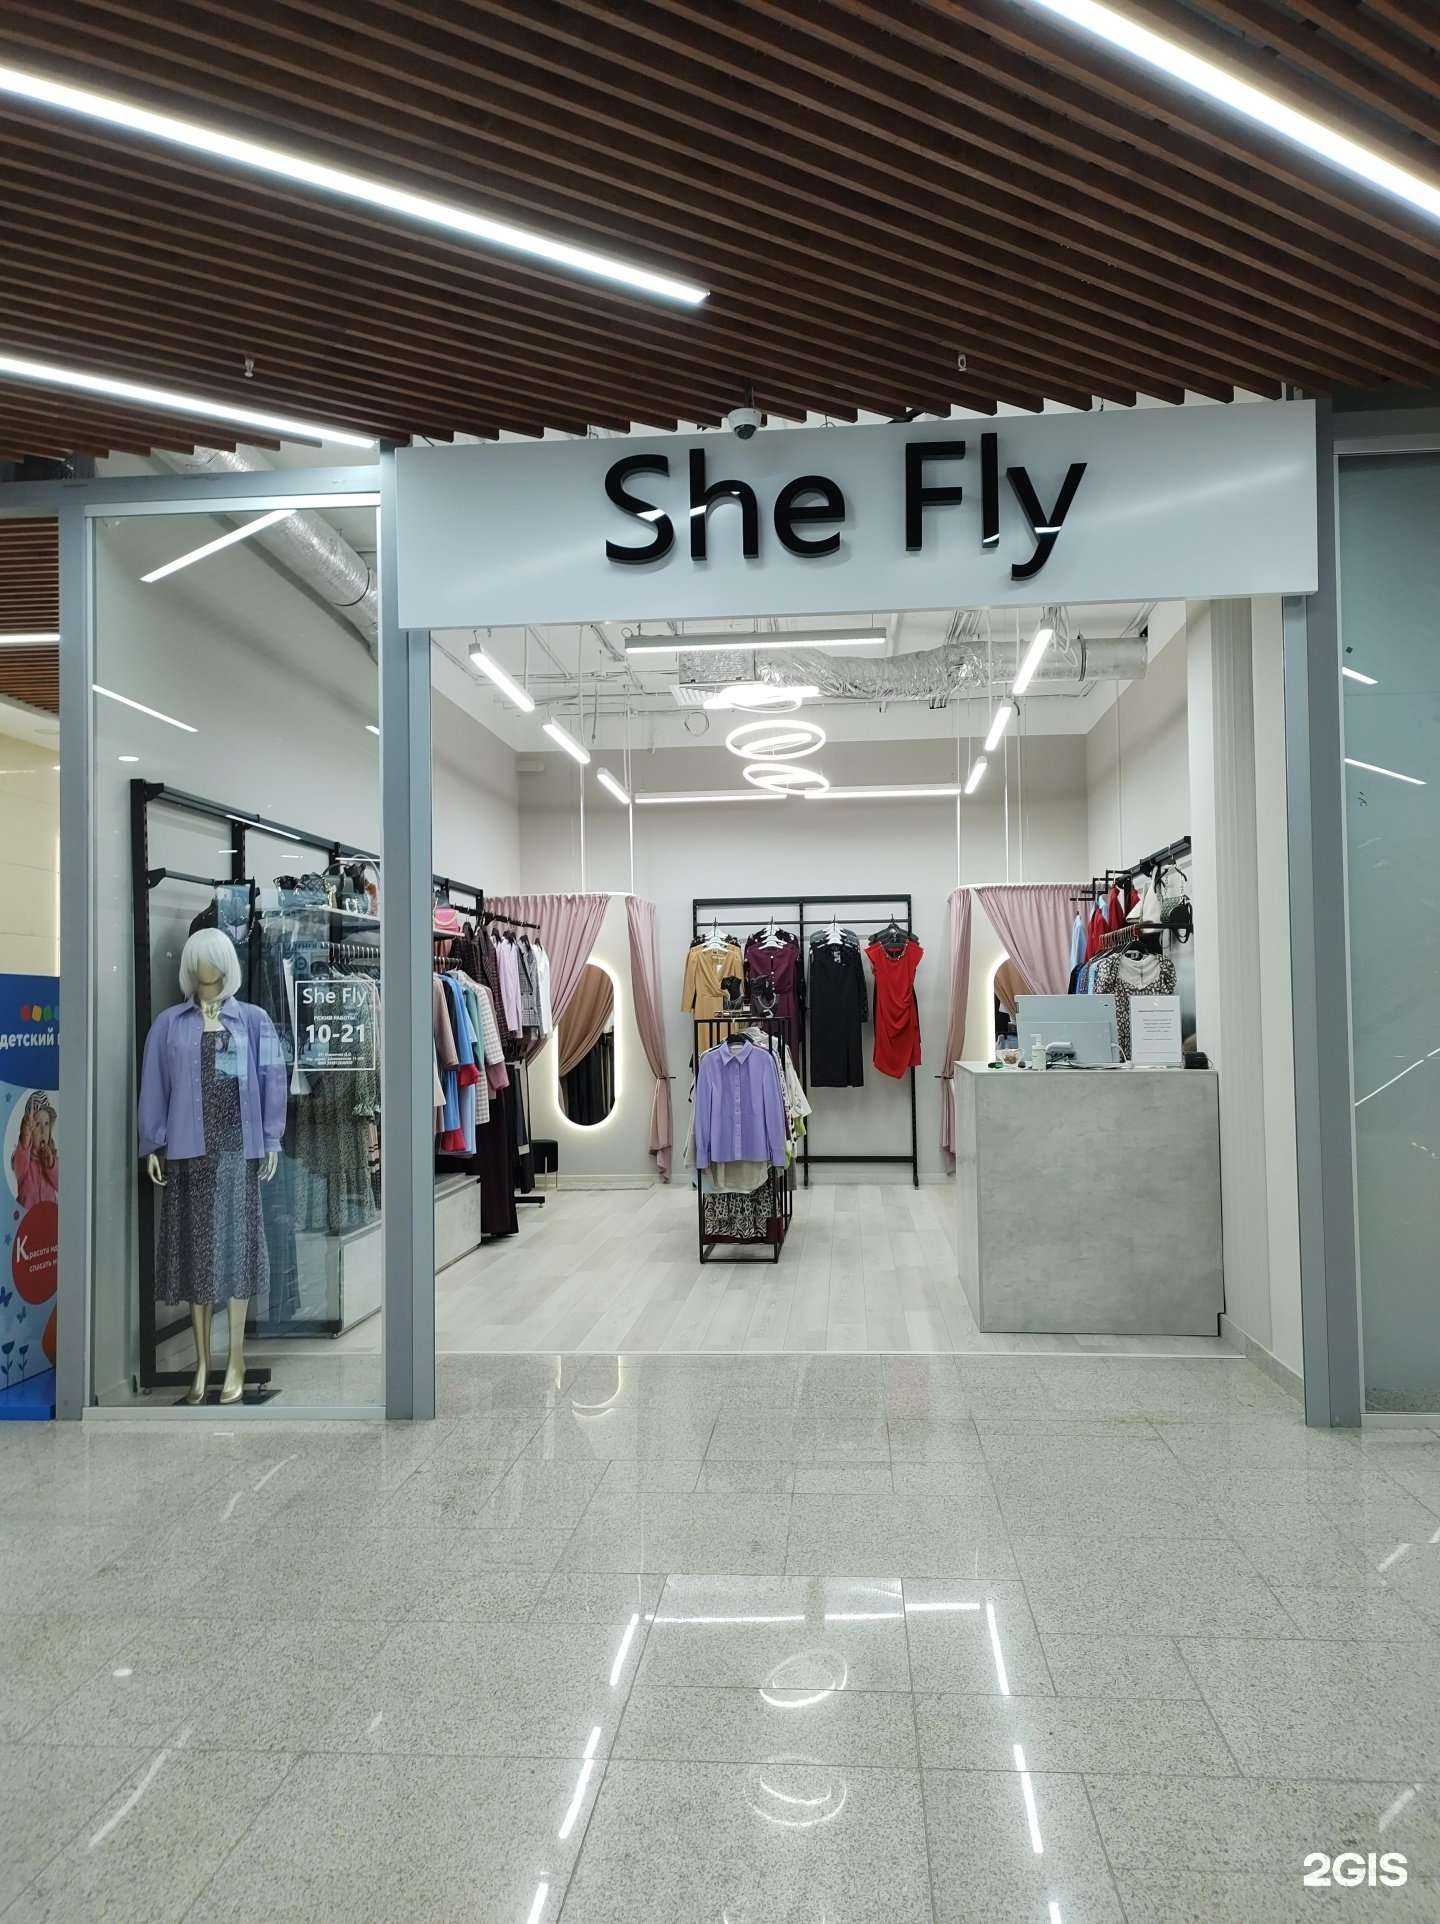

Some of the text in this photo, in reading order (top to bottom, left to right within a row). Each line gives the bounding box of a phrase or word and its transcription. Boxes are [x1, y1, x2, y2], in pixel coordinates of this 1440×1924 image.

[605, 433, 1088, 581] She Fly
[302, 986, 367, 1007] She Fly
[0, 1026, 54, 1050] детский
[305, 1024, 365, 1043] 10-21
